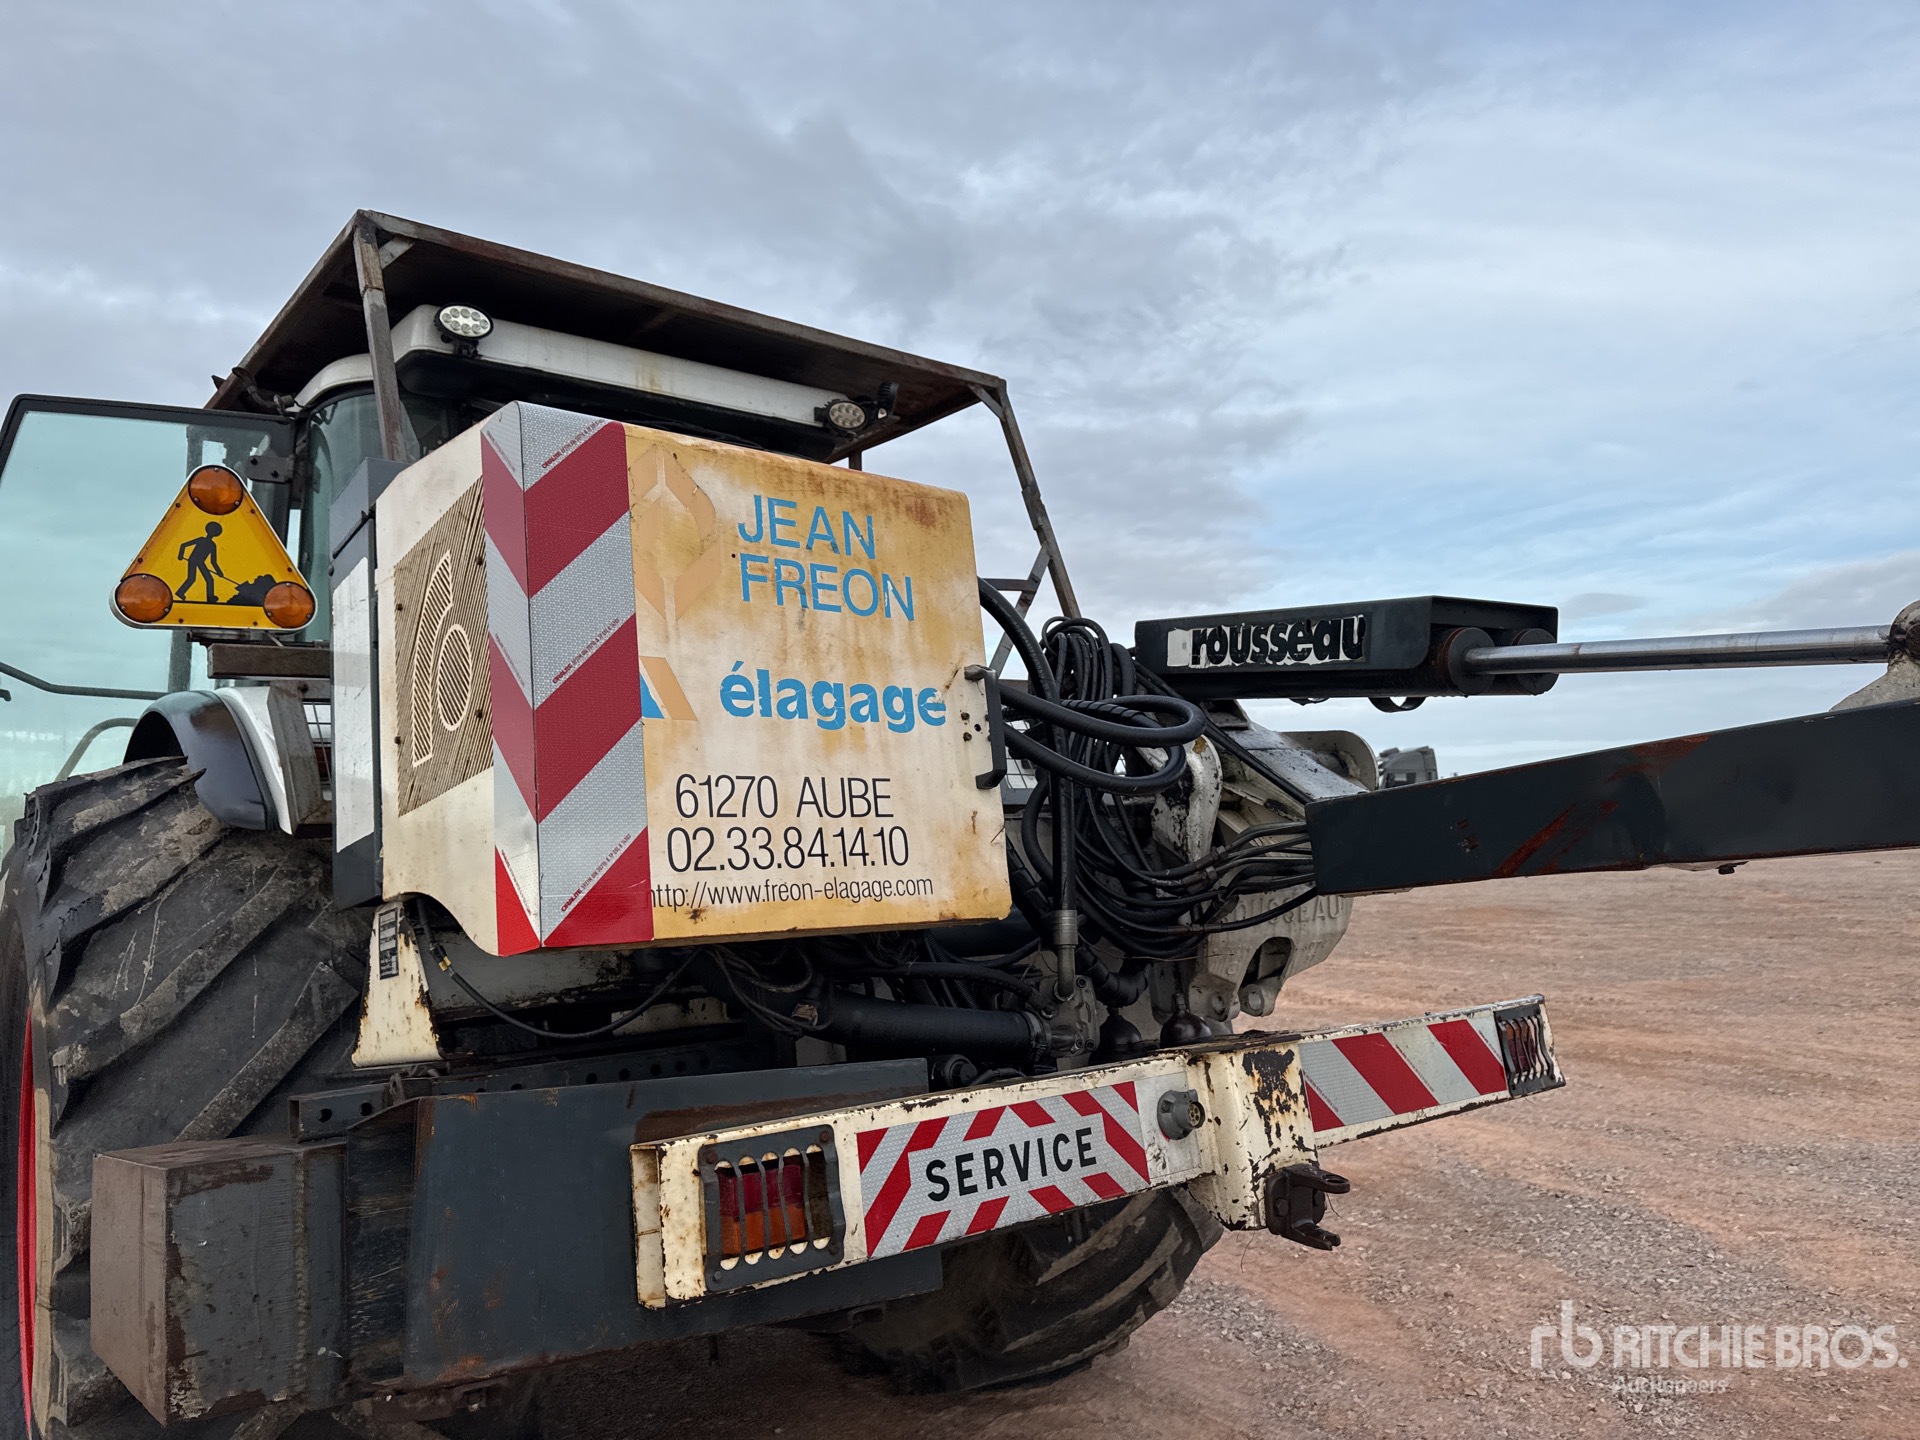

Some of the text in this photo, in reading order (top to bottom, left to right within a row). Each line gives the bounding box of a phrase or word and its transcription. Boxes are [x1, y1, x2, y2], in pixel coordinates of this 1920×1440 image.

[738, 495, 876, 560] JEAN
[740, 553, 915, 621] FREON
[1191, 614, 1367, 667] rousseau
[720, 661, 947, 734] élagage
[675, 773, 894, 819] 61270 AUBE
[667, 826, 909, 872] 02.33.84.14.10
[1216, 895, 1340, 925] OUSSEAU
[925, 1127, 1097, 1202] SERVICE
